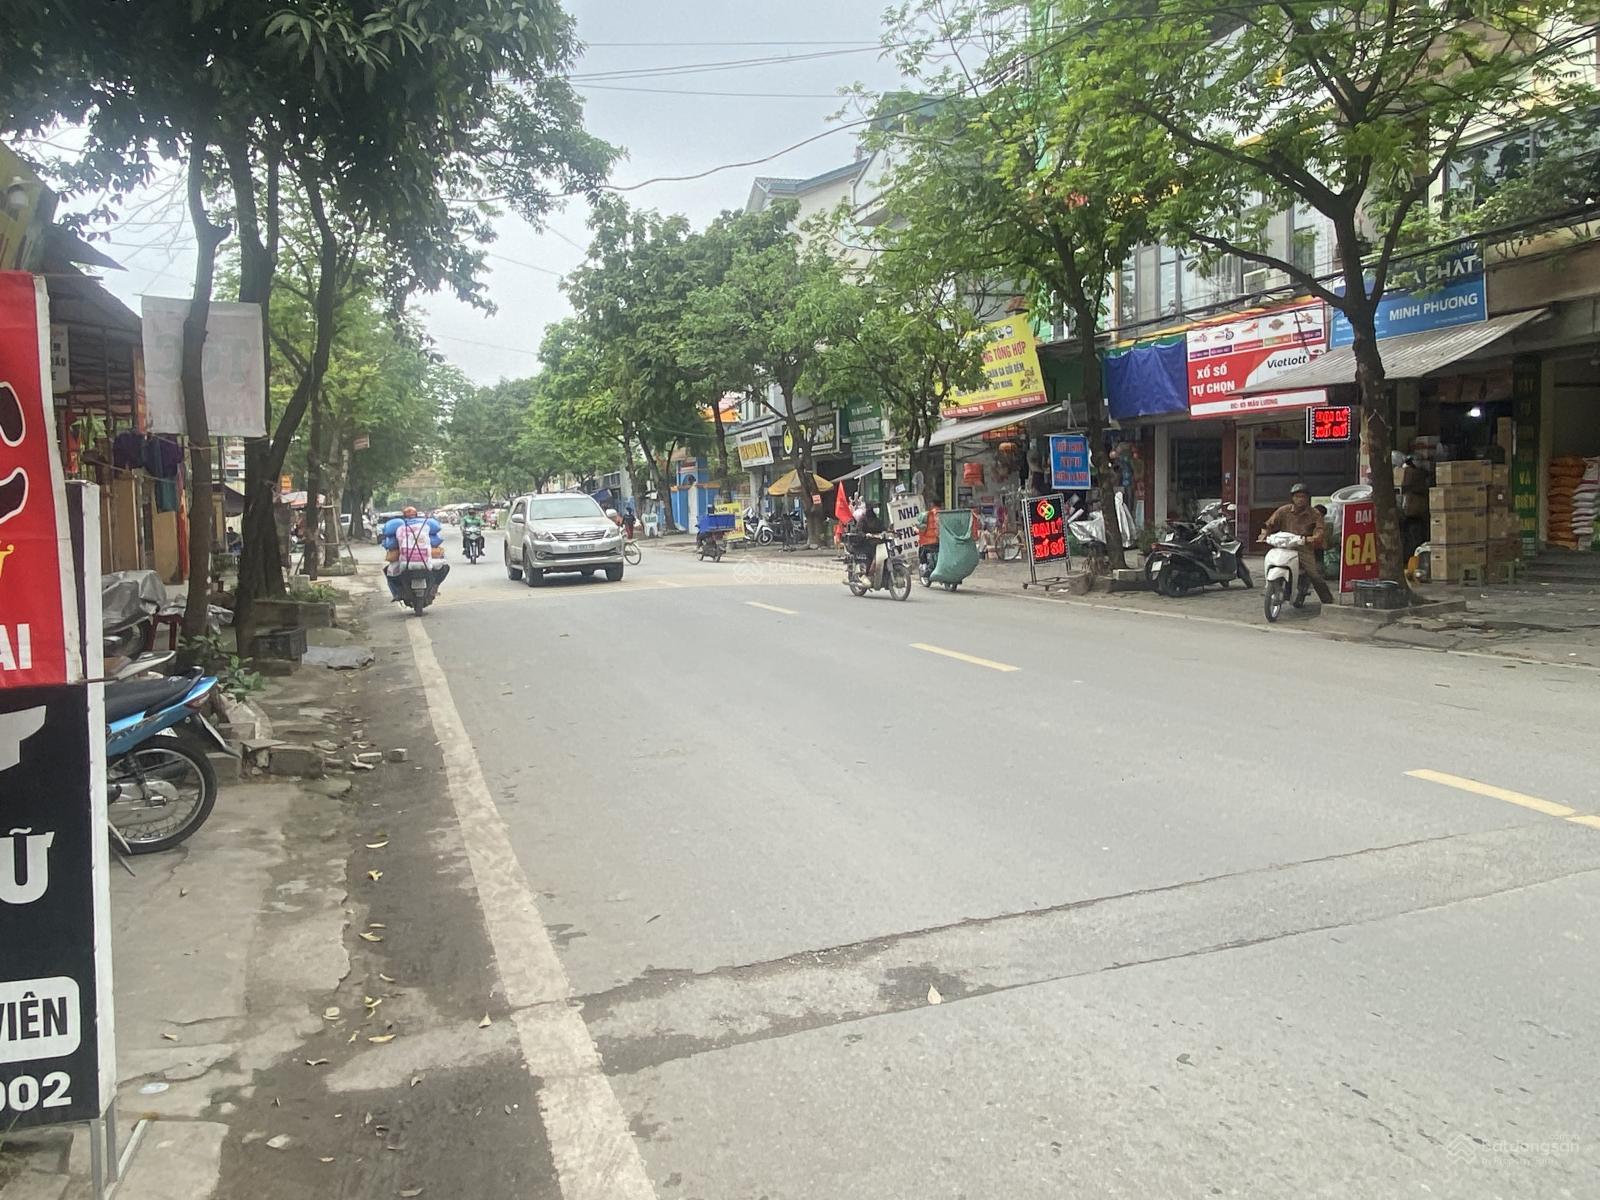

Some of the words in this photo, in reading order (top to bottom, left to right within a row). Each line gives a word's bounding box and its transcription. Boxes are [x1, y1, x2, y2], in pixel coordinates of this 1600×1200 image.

[1389, 303, 1420, 321] MINH
[1423, 292, 1478, 314] PHƯƠNG
[1213, 361, 1228, 377] SỐ
[1267, 354, 1307, 369] Vietlott
[1191, 384, 1205, 397] TỰ
[1206, 381, 1236, 395] CHỌN
